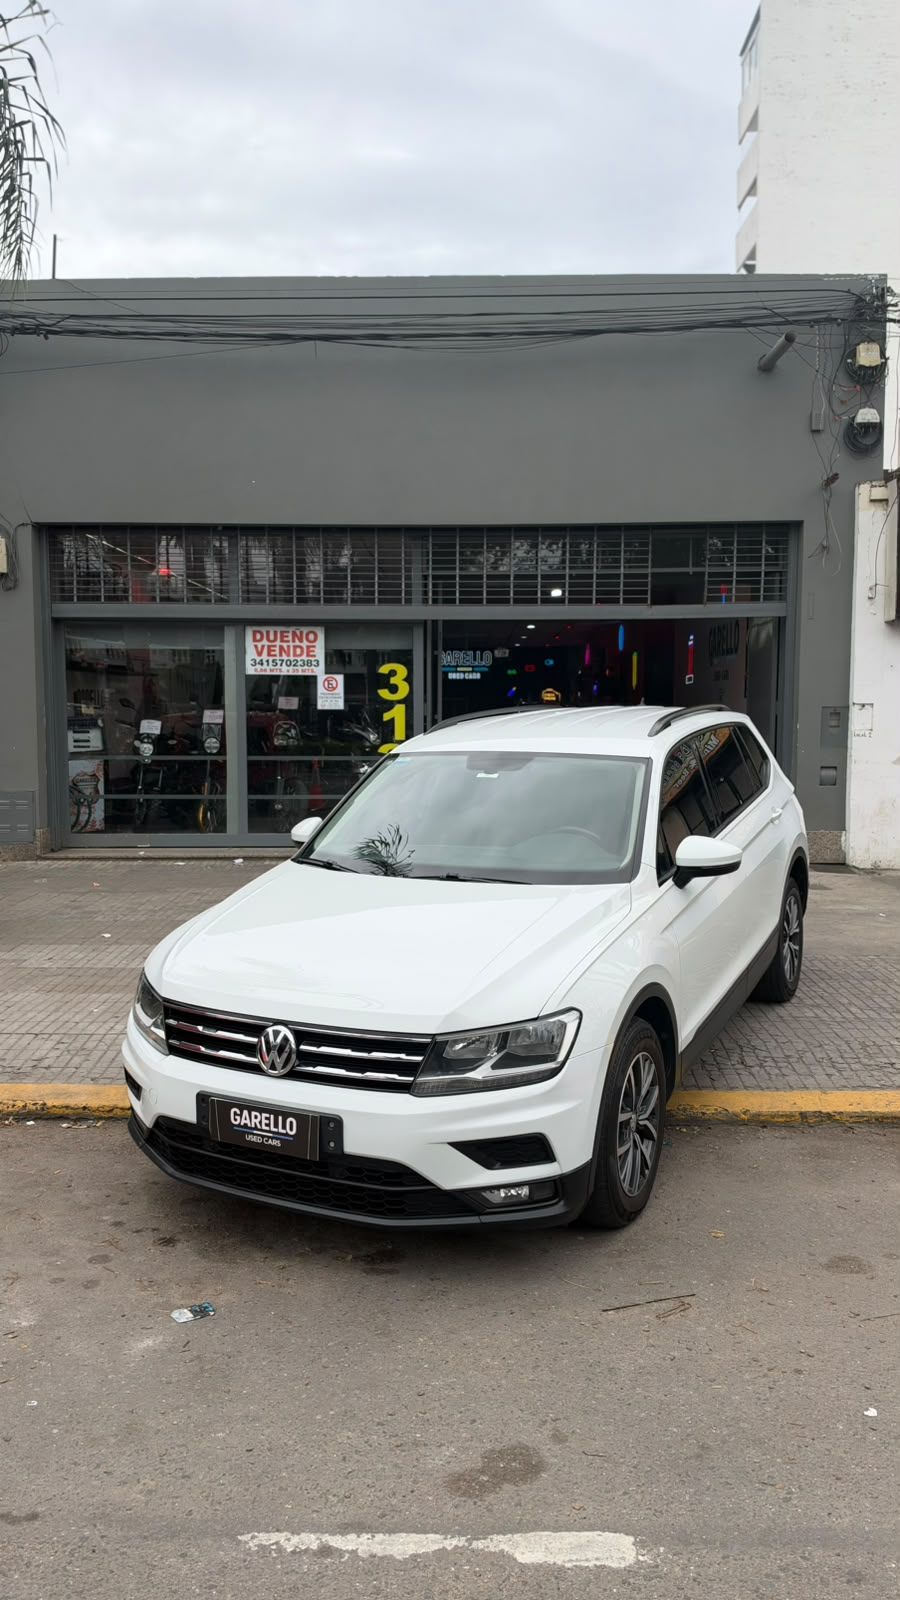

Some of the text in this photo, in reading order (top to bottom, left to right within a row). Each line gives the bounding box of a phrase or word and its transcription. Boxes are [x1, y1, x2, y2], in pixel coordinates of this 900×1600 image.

[252, 628, 318, 643] DUEÑO
[254, 644, 317, 657] VENDE
[250, 658, 320, 668] 3415702383
[377, 662, 410, 754] 31
[230, 1107, 297, 1136] GARELLO
[245, 1134, 281, 1147] USED CARS
